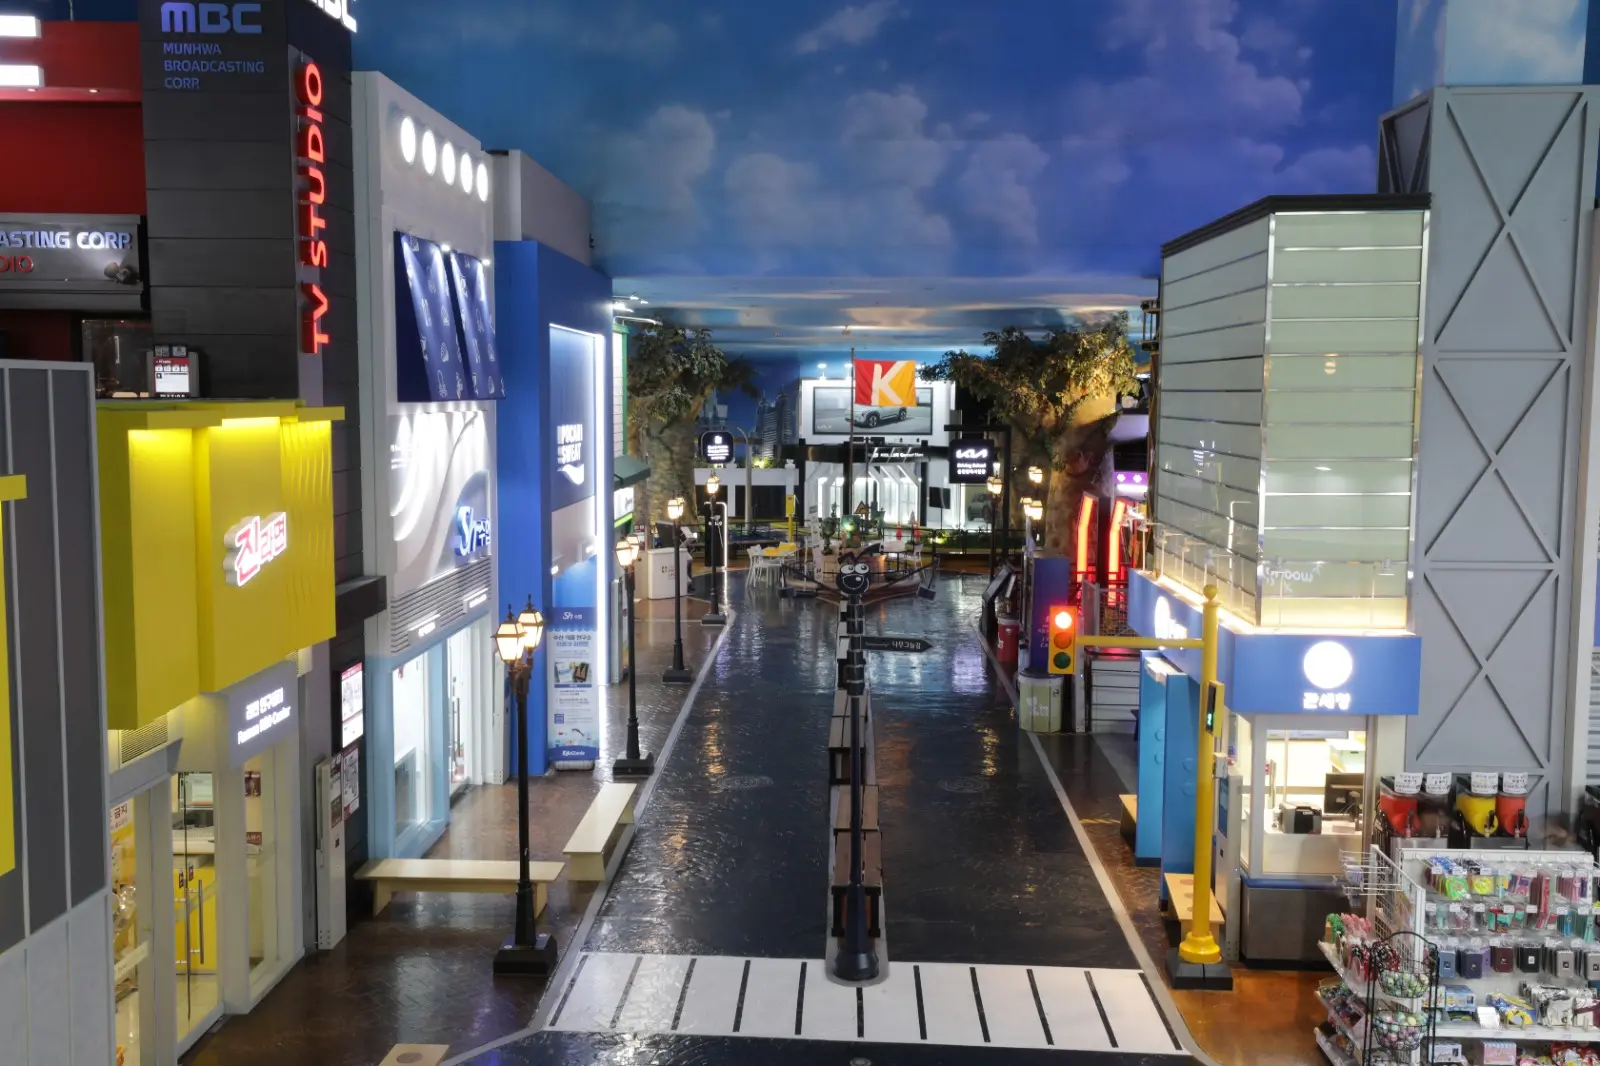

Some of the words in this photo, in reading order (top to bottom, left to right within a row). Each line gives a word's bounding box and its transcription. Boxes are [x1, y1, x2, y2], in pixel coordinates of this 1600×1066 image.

[160, 1, 263, 35] MBC
[162, 42, 223, 56] MUNHWA
[163, 59, 266, 74] BROADCASTING
[163, 76, 201, 90] CORP.
[301, 60, 328, 270] STUDIO
[76, 231, 133, 249] CORP.
[307, 284, 331, 355] TV
[560, 443, 582, 464] SWEAT
[235, 512, 287, 587] 진라면
[113, 803, 128, 819] 금지
